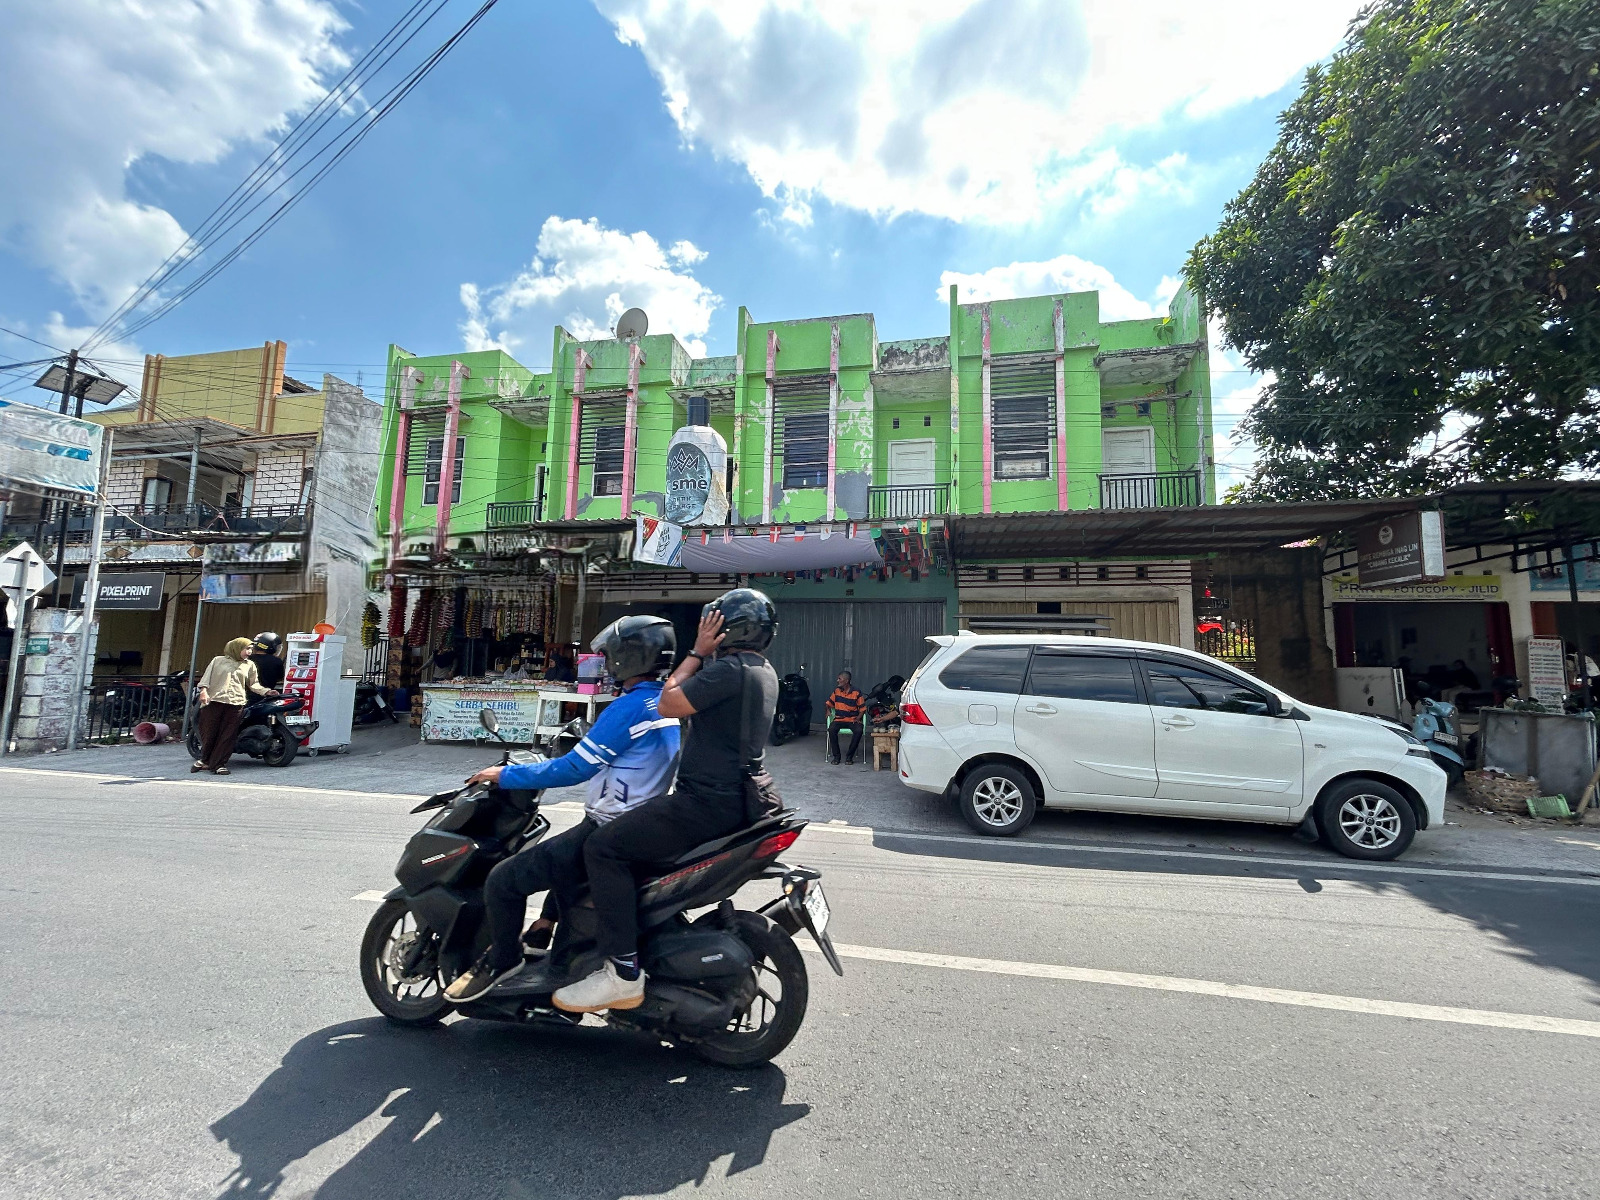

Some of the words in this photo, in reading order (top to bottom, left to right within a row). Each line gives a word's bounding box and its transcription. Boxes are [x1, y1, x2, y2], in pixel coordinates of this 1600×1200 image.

[100, 585, 152, 596] PIXELPRINT
[1468, 585, 1499, 594] JILID
[455, 700, 483, 710] SERBA
[486, 701, 520, 711] SERIBU
